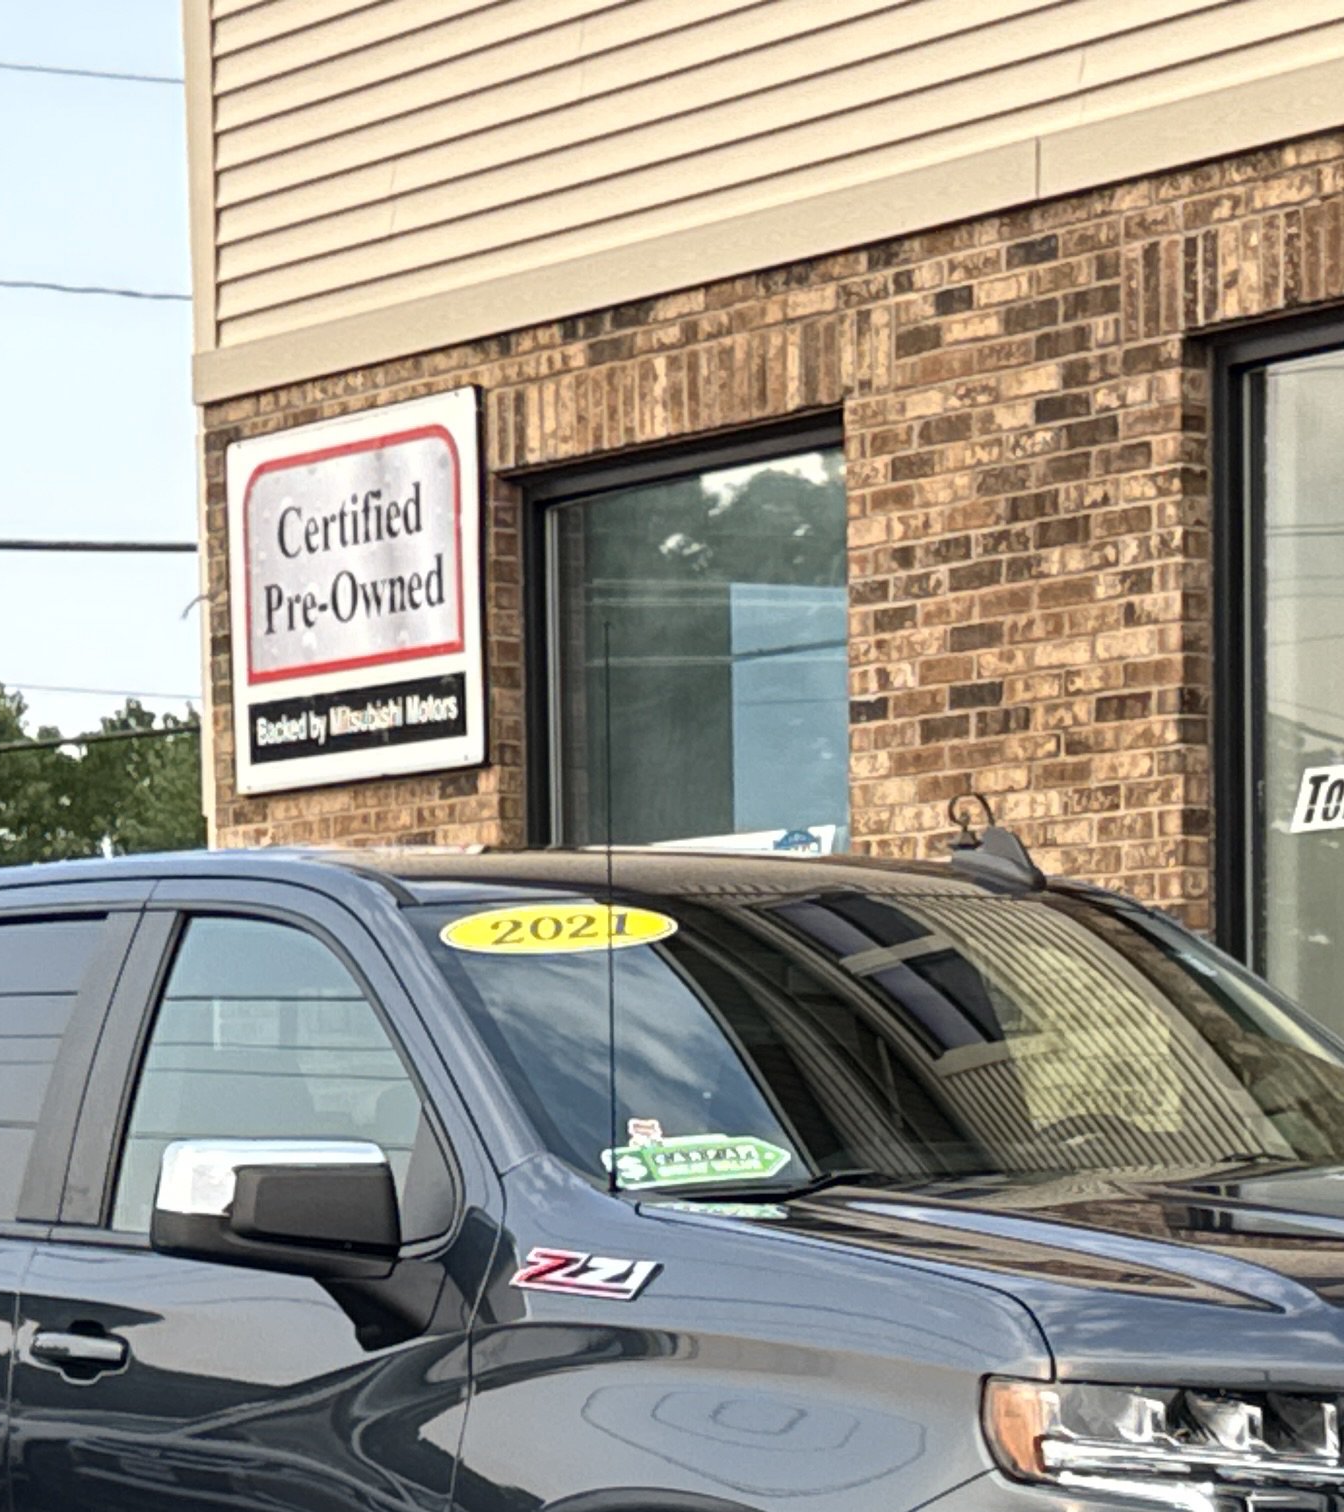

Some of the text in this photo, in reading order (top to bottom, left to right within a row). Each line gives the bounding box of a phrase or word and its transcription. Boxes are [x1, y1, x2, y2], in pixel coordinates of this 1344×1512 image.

[278, 481, 423, 559] Certified
[264, 554, 445, 635] Pre-Owned
[257, 694, 459, 746] Backed by Mitsubishi Motors
[490, 913, 633, 946] 2021
[508, 1246, 665, 1303] Z71
